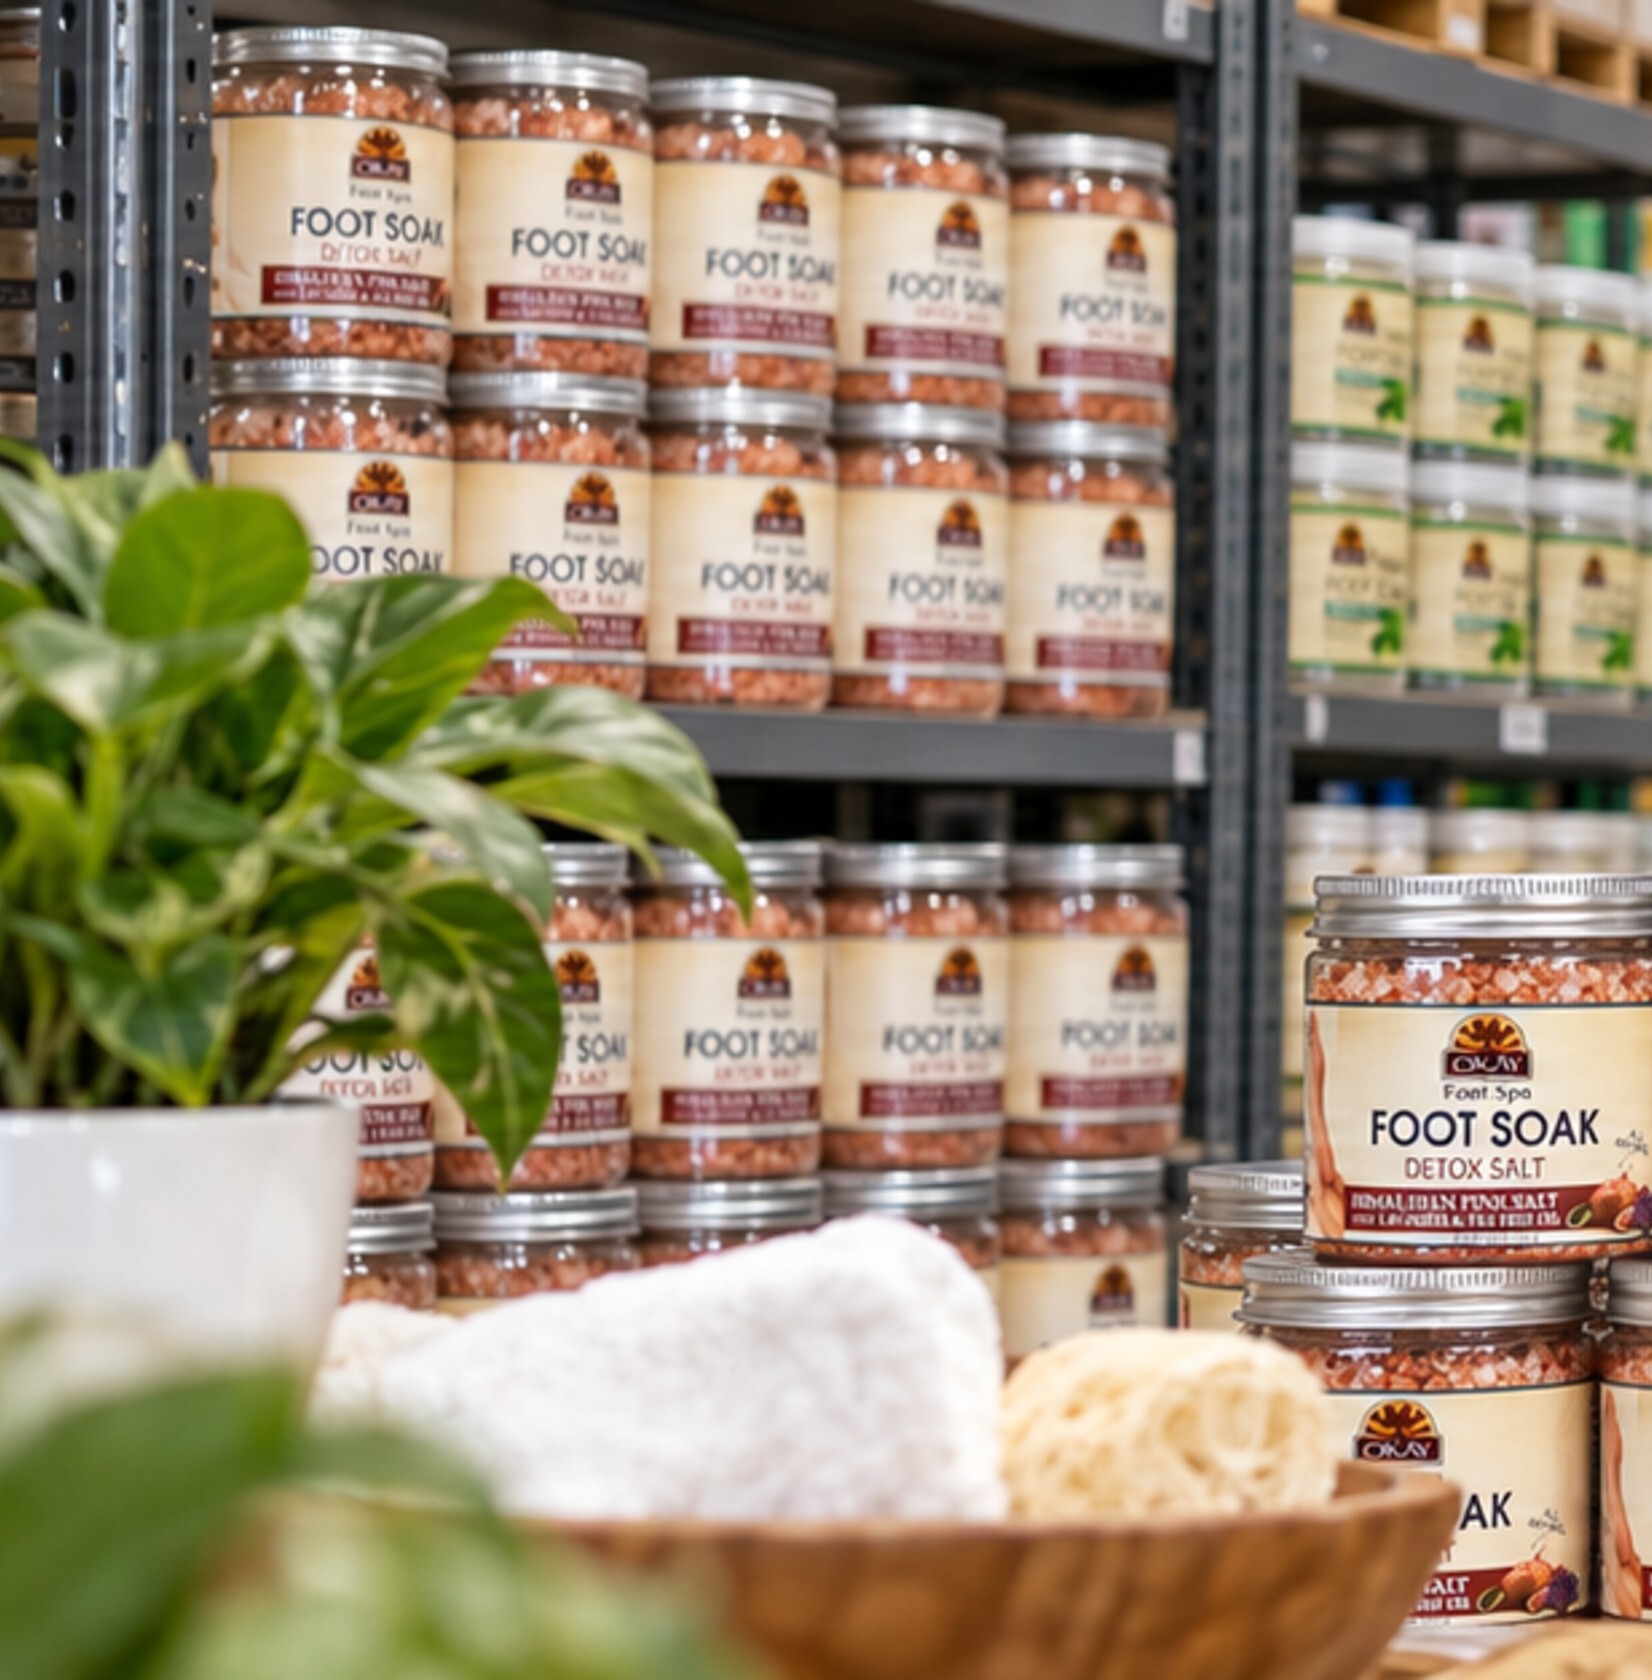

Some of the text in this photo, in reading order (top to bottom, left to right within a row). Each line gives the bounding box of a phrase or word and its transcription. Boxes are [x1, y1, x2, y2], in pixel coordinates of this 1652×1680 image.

[291, 207, 374, 237] FOOT
[512, 228, 589, 258] FOOT
[706, 249, 780, 279] FOOT
[311, 546, 374, 575] OOT
[510, 553, 587, 583] FOOT
[702, 562, 775, 593] FOOT
[685, 1029, 760, 1058] FOOT
[884, 1026, 953, 1055] FOOT
[1371, 1108, 1599, 1146] FOOT SOAK
[1405, 1157, 1545, 1179] DETOX SALT
[1459, 1491, 1512, 1531] AK
